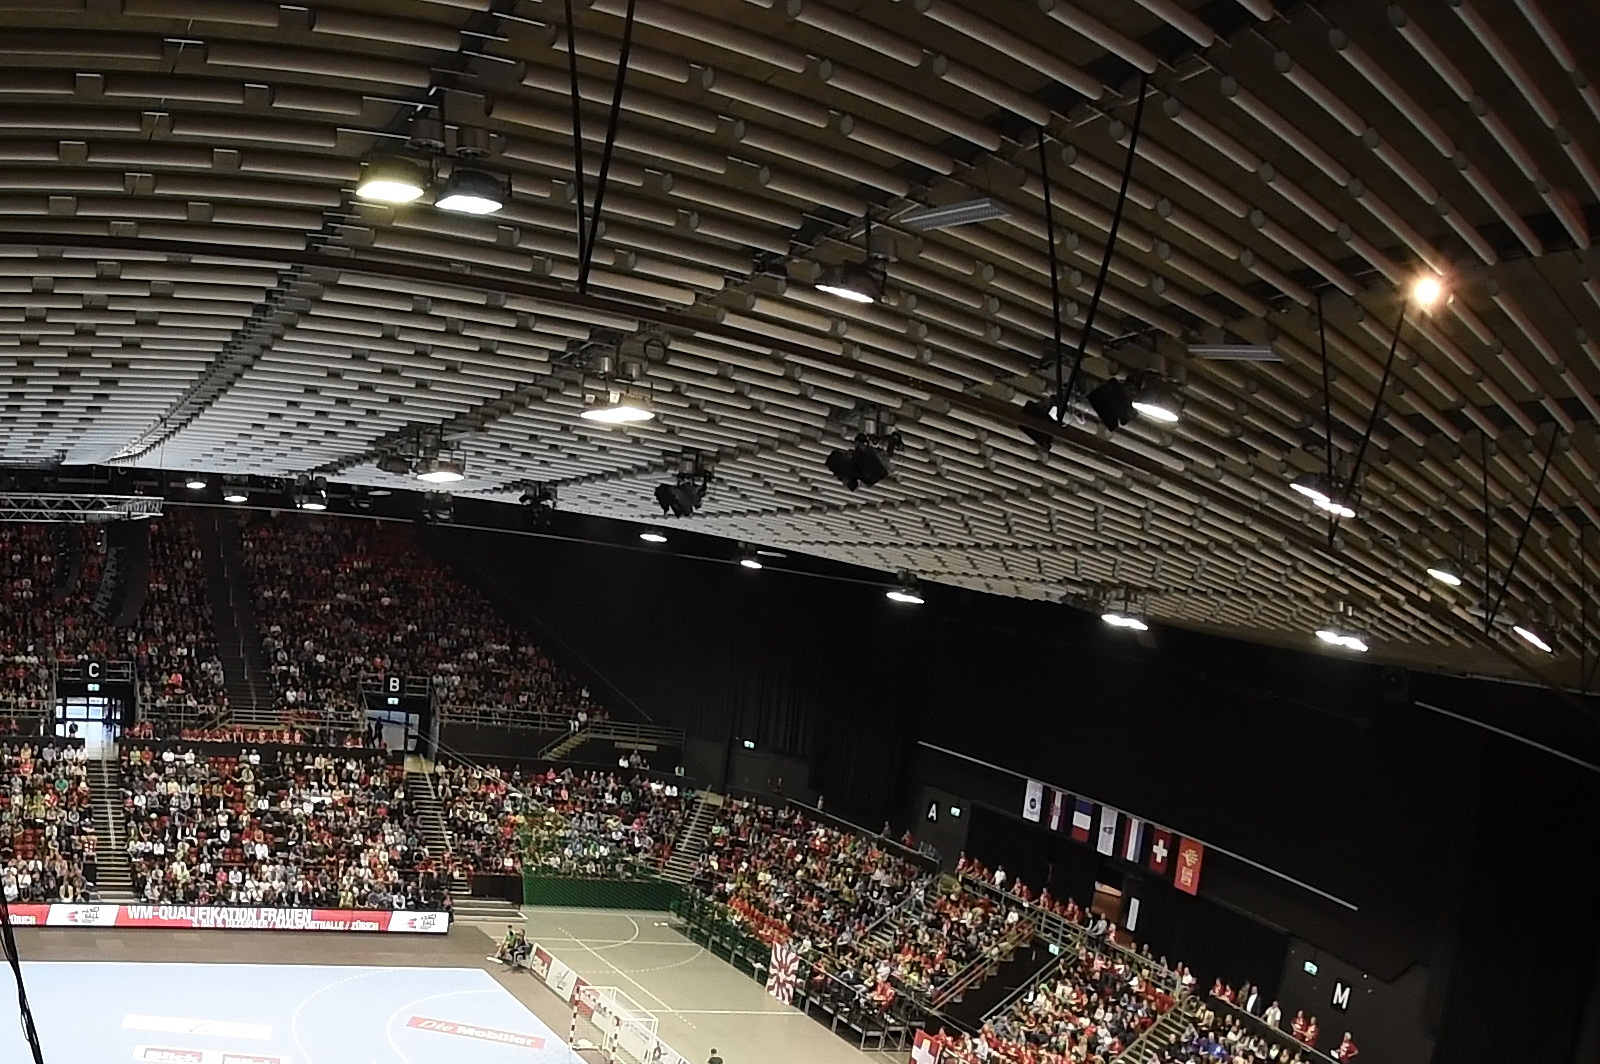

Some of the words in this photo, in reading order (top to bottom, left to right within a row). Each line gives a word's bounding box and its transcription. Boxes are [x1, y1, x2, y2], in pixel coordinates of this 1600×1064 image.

[88, 662, 100, 678] C
[389, 677, 400, 692] B
[927, 802, 937, 821] A
[127, 905, 260, 922] WM-QUALIFIKATION
[262, 908, 313, 922] FRAUEN
[1333, 982, 1351, 1010] M
[417, 1019, 454, 1032] Die
[455, 1025, 536, 1046] Mobiliar
